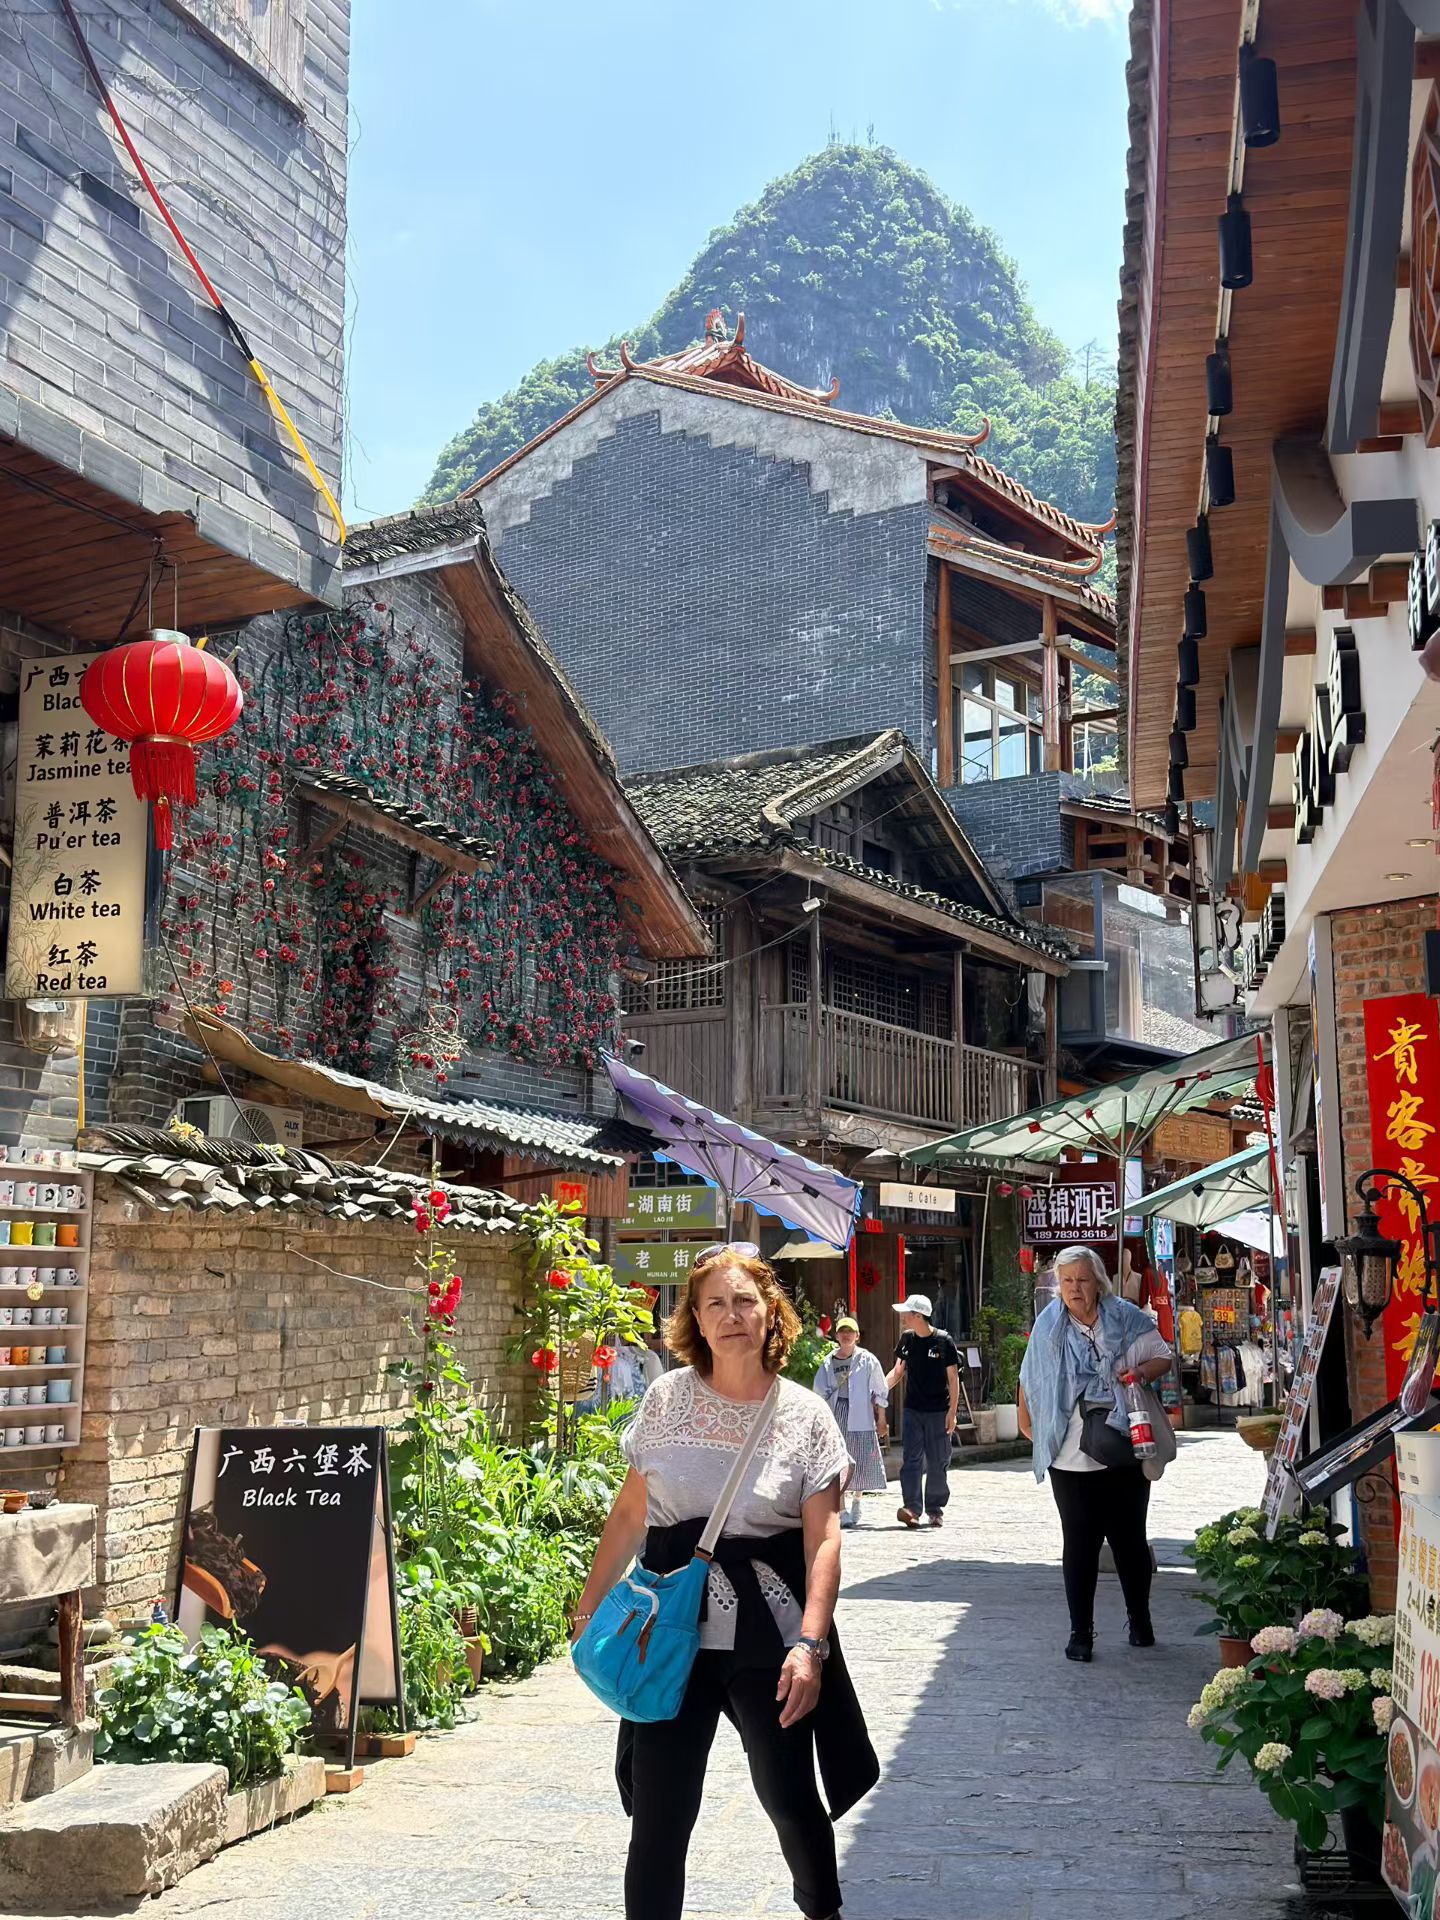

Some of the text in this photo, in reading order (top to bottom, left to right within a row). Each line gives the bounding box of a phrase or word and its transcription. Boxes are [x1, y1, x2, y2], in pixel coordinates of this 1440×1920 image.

[43, 693, 81, 711] Blac
[35, 728, 128, 760] 茉莉花茶
[26, 760, 101, 781] Jasmine
[43, 797, 118, 829] 普洱茶
[37, 830, 120, 850] Pu'er tea
[54, 869, 102, 896] 白茶
[30, 901, 120, 920] White tea
[48, 940, 98, 967] 红茶
[37, 973, 107, 991] Red tea
[638, 1194, 692, 1213] 湖南街
[1027, 1187, 1113, 1228] 盛锦酒店
[1034, 1230, 1107, 1239] 189 7830 3618
[217, 1442, 372, 1478] 广西六堡茶
[242, 1487, 341, 1507] Black Tea
